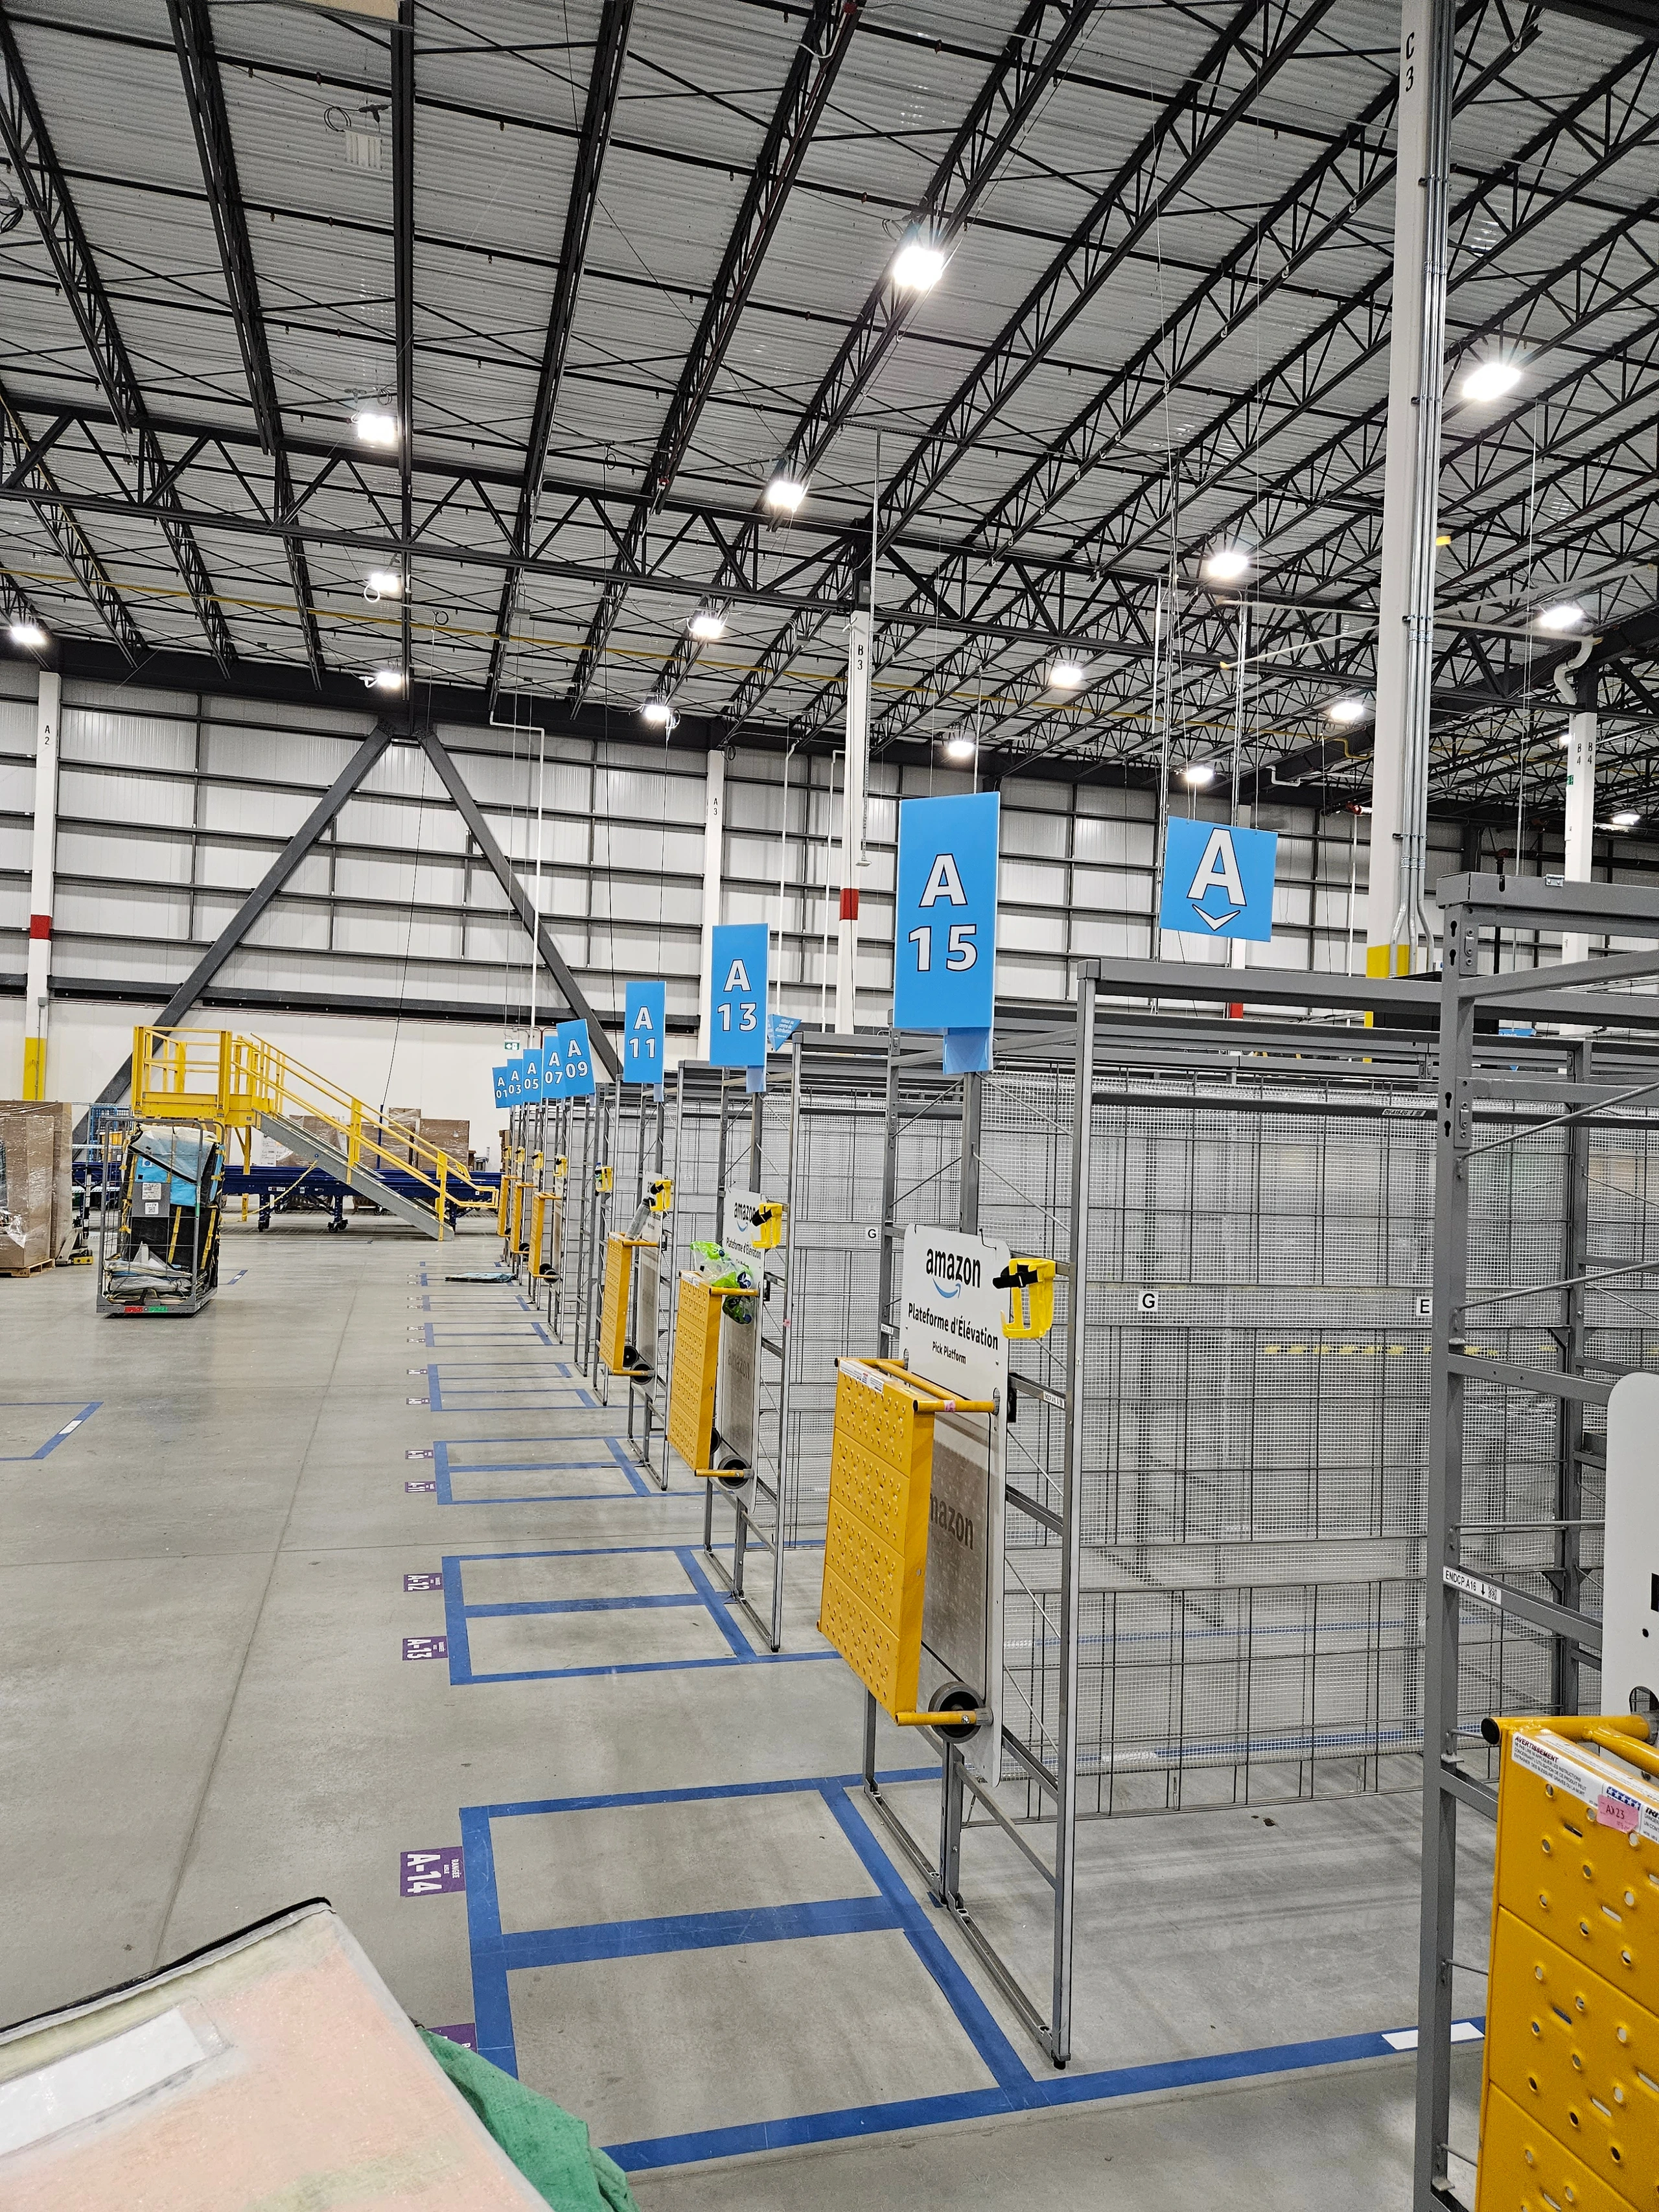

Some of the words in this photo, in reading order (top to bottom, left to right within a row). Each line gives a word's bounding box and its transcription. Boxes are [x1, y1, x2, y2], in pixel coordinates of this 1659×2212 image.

[1187, 828, 1247, 907] A
[918, 853, 968, 909] A
[909, 924, 978, 972] 15
[723, 959, 752, 992] A
[633, 1006, 653, 1030] A
[717, 1002, 758, 1032] 13
[567, 1038, 583, 1058] A
[629, 1037, 656, 1058] 11
[526, 1062, 537, 1075] A
[548, 1051, 561, 1067] A
[565, 1060, 588, 1078] 09
[496, 1077, 505, 1087] A
[510, 1070, 520, 1082] A
[524, 1078, 539, 1090] 05
[544, 1071, 563, 1085] 07
[495, 1089, 507, 1099] 01
[508, 1084, 522, 1095] 03
[867, 1228, 877, 1239] G
[925, 1248, 981, 1288] amazon
[1142, 1293, 1155, 1309] G
[1420, 1299, 1431, 1313] E
[908, 1301, 949, 1333] Plateforme
[950, 1315, 999, 1351] d'Élévation
[932, 1340, 943, 1355] Pick
[944, 1344, 967, 1365] Platform
[930, 1493, 973, 1550] mazon
[407, 1574, 430, 1592] A-12
[406, 1638, 432, 1659] A-13
[1515, 1736, 1559, 1763] AVERTISSEMENT
[407, 1854, 443, 1893] A-14
[451, 1859, 461, 1879] RANGÉE
